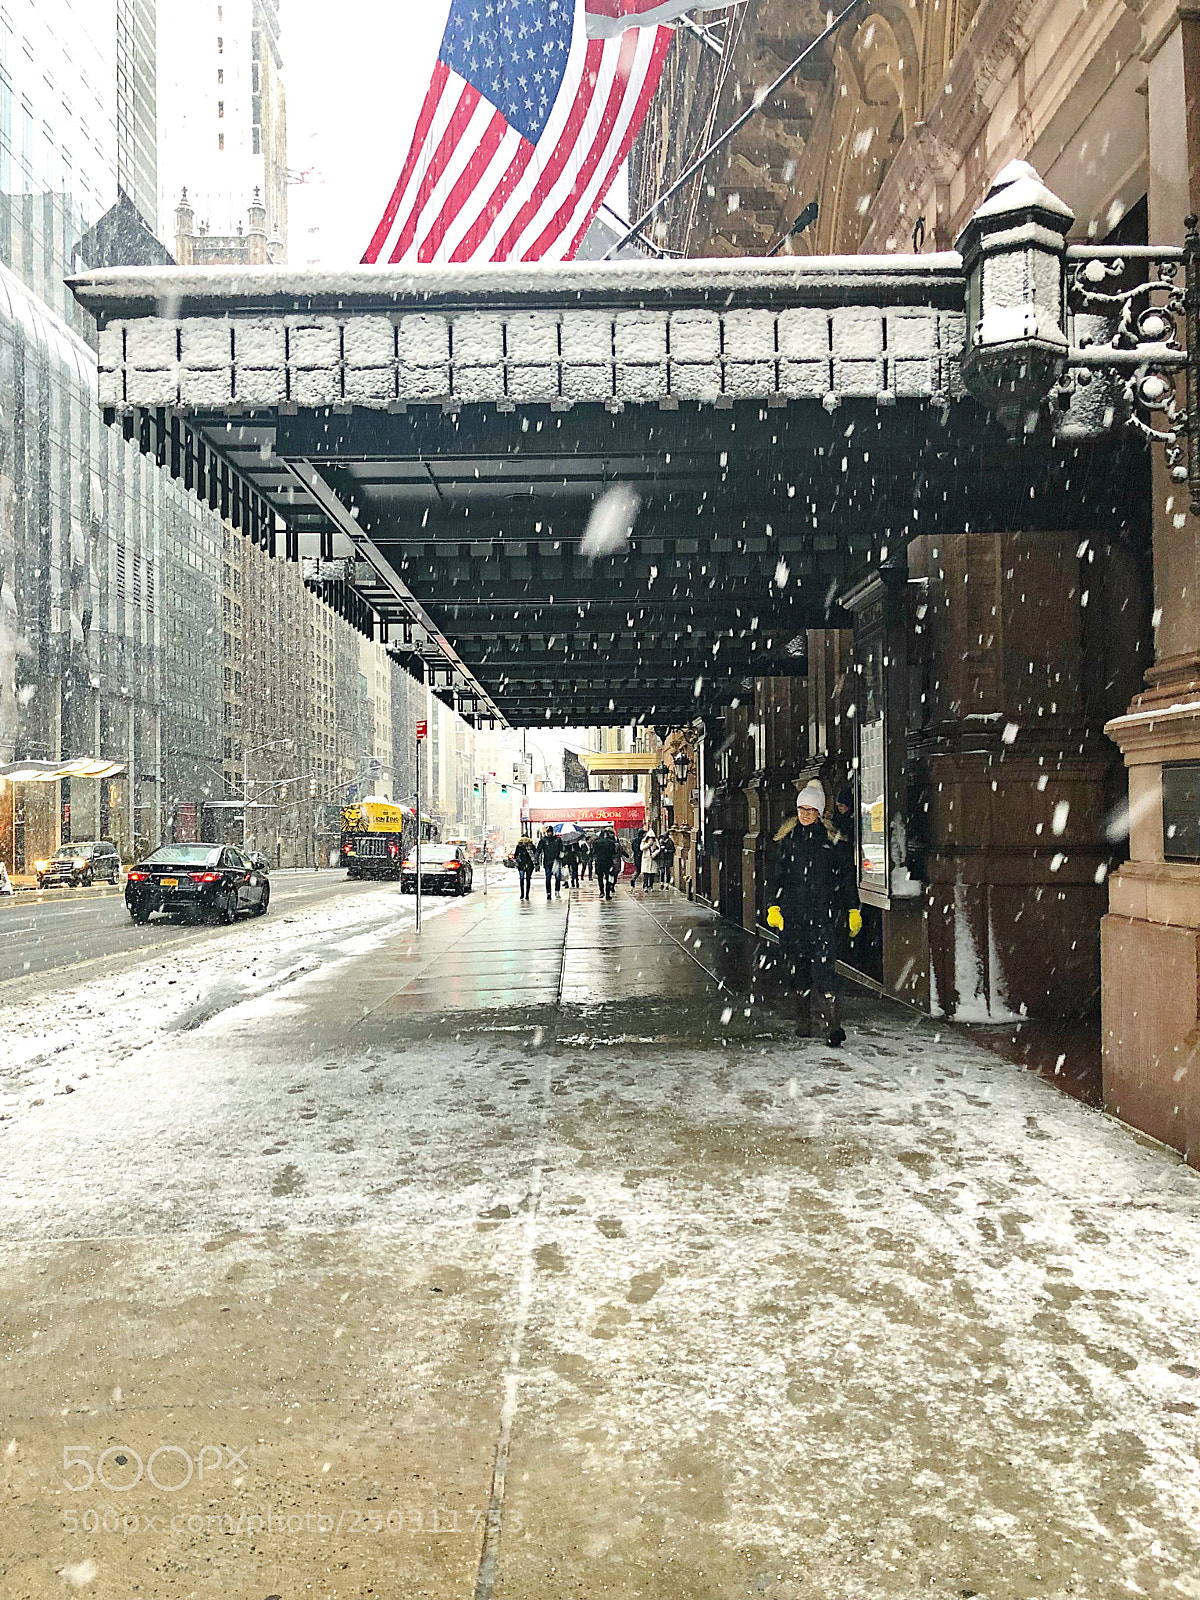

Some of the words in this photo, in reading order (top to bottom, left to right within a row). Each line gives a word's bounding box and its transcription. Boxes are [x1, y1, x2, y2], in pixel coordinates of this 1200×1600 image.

[543, 811, 576, 820] RUSSIAN
[578, 810, 594, 819] TEA
[596, 810, 622, 819] ROOM
